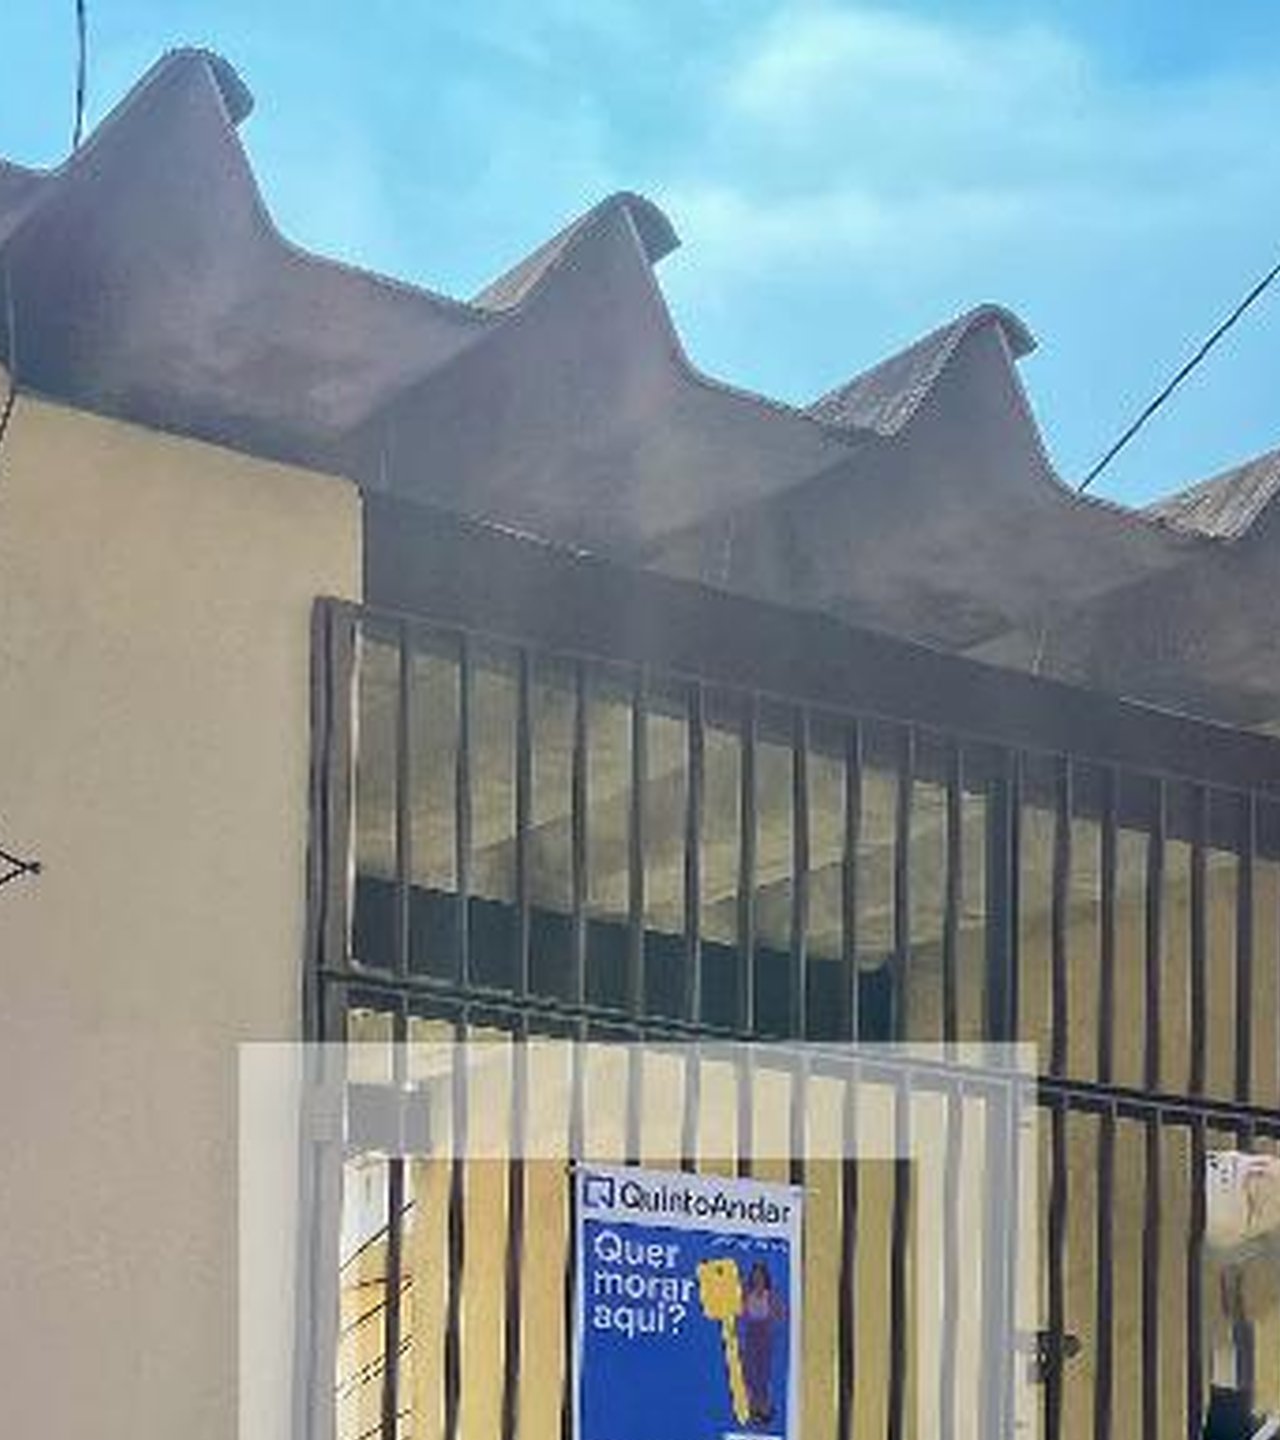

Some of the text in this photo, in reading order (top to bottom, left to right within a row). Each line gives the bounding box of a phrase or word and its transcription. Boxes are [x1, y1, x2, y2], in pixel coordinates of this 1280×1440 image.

[621, 1180, 791, 1224] QuintoAndar
[593, 1230, 679, 1268] Quer
[594, 1269, 696, 1301] morar
[593, 1303, 686, 1339] aqui?
